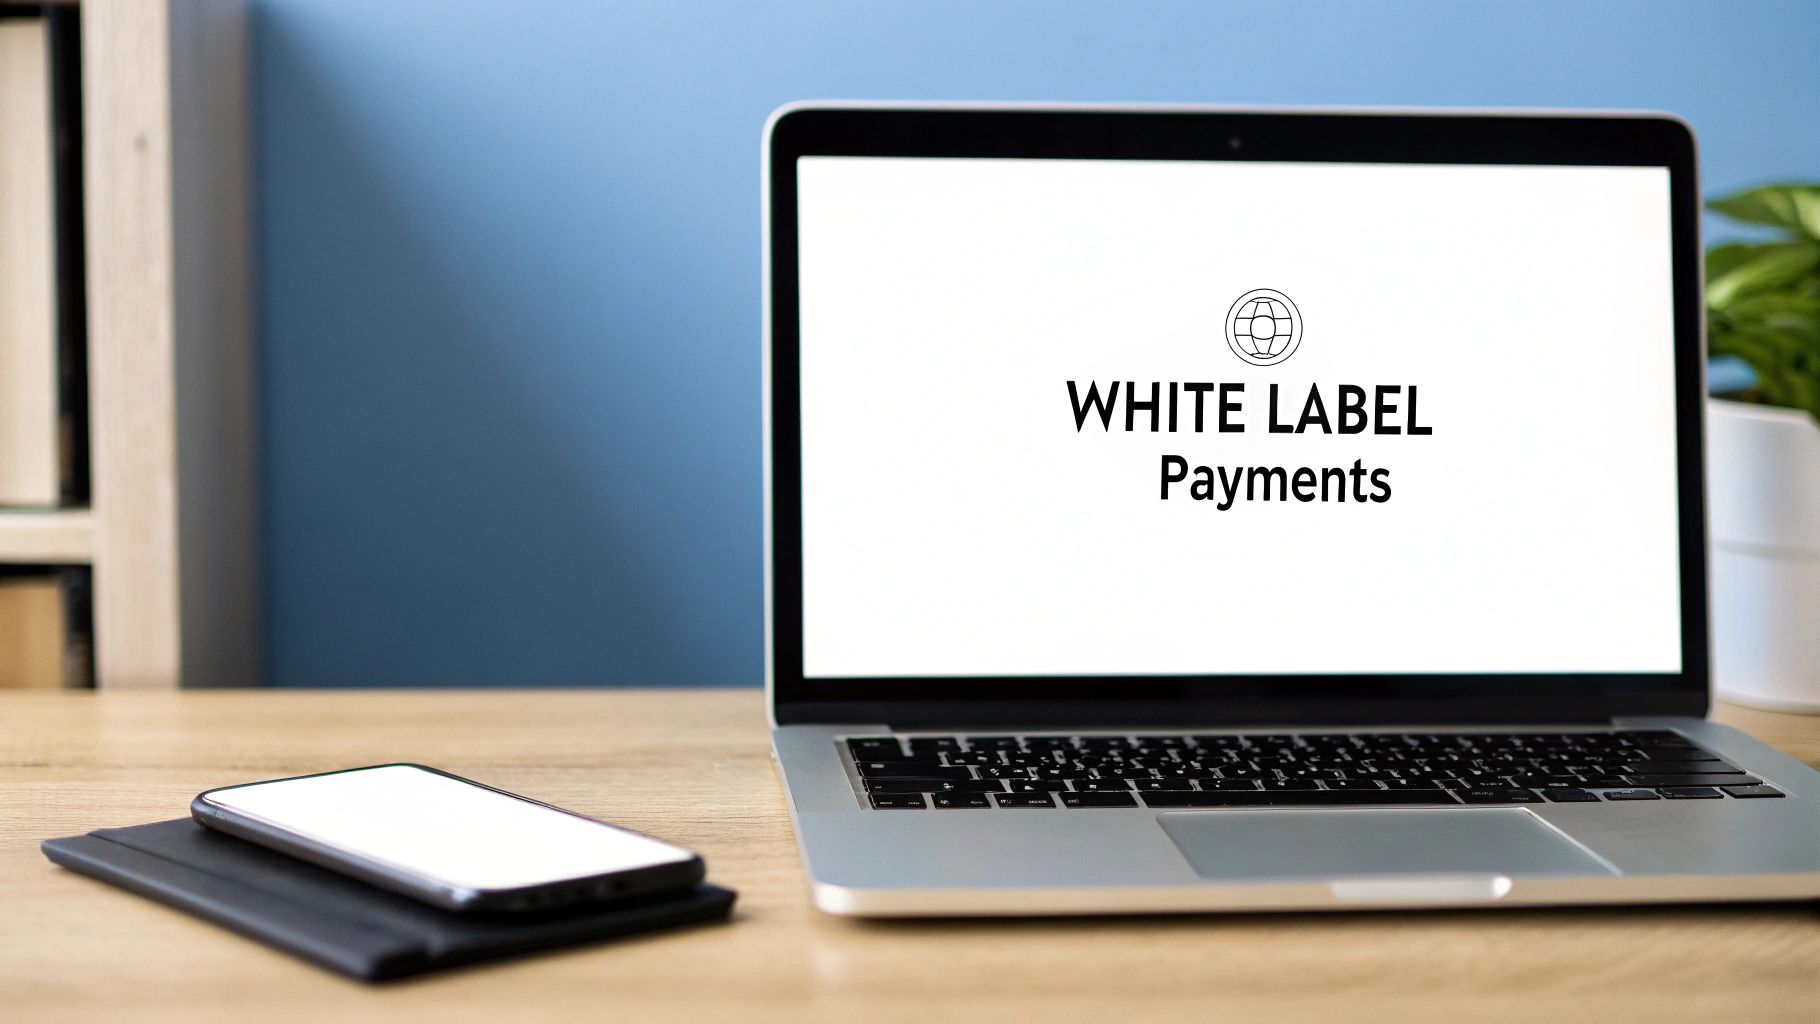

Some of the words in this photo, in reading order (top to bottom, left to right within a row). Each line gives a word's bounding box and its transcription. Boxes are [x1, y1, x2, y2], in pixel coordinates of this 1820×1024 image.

[1066, 379, 1245, 433] WHITE
[1268, 383, 1433, 436] LABEL
[1160, 454, 1392, 512] Payments
